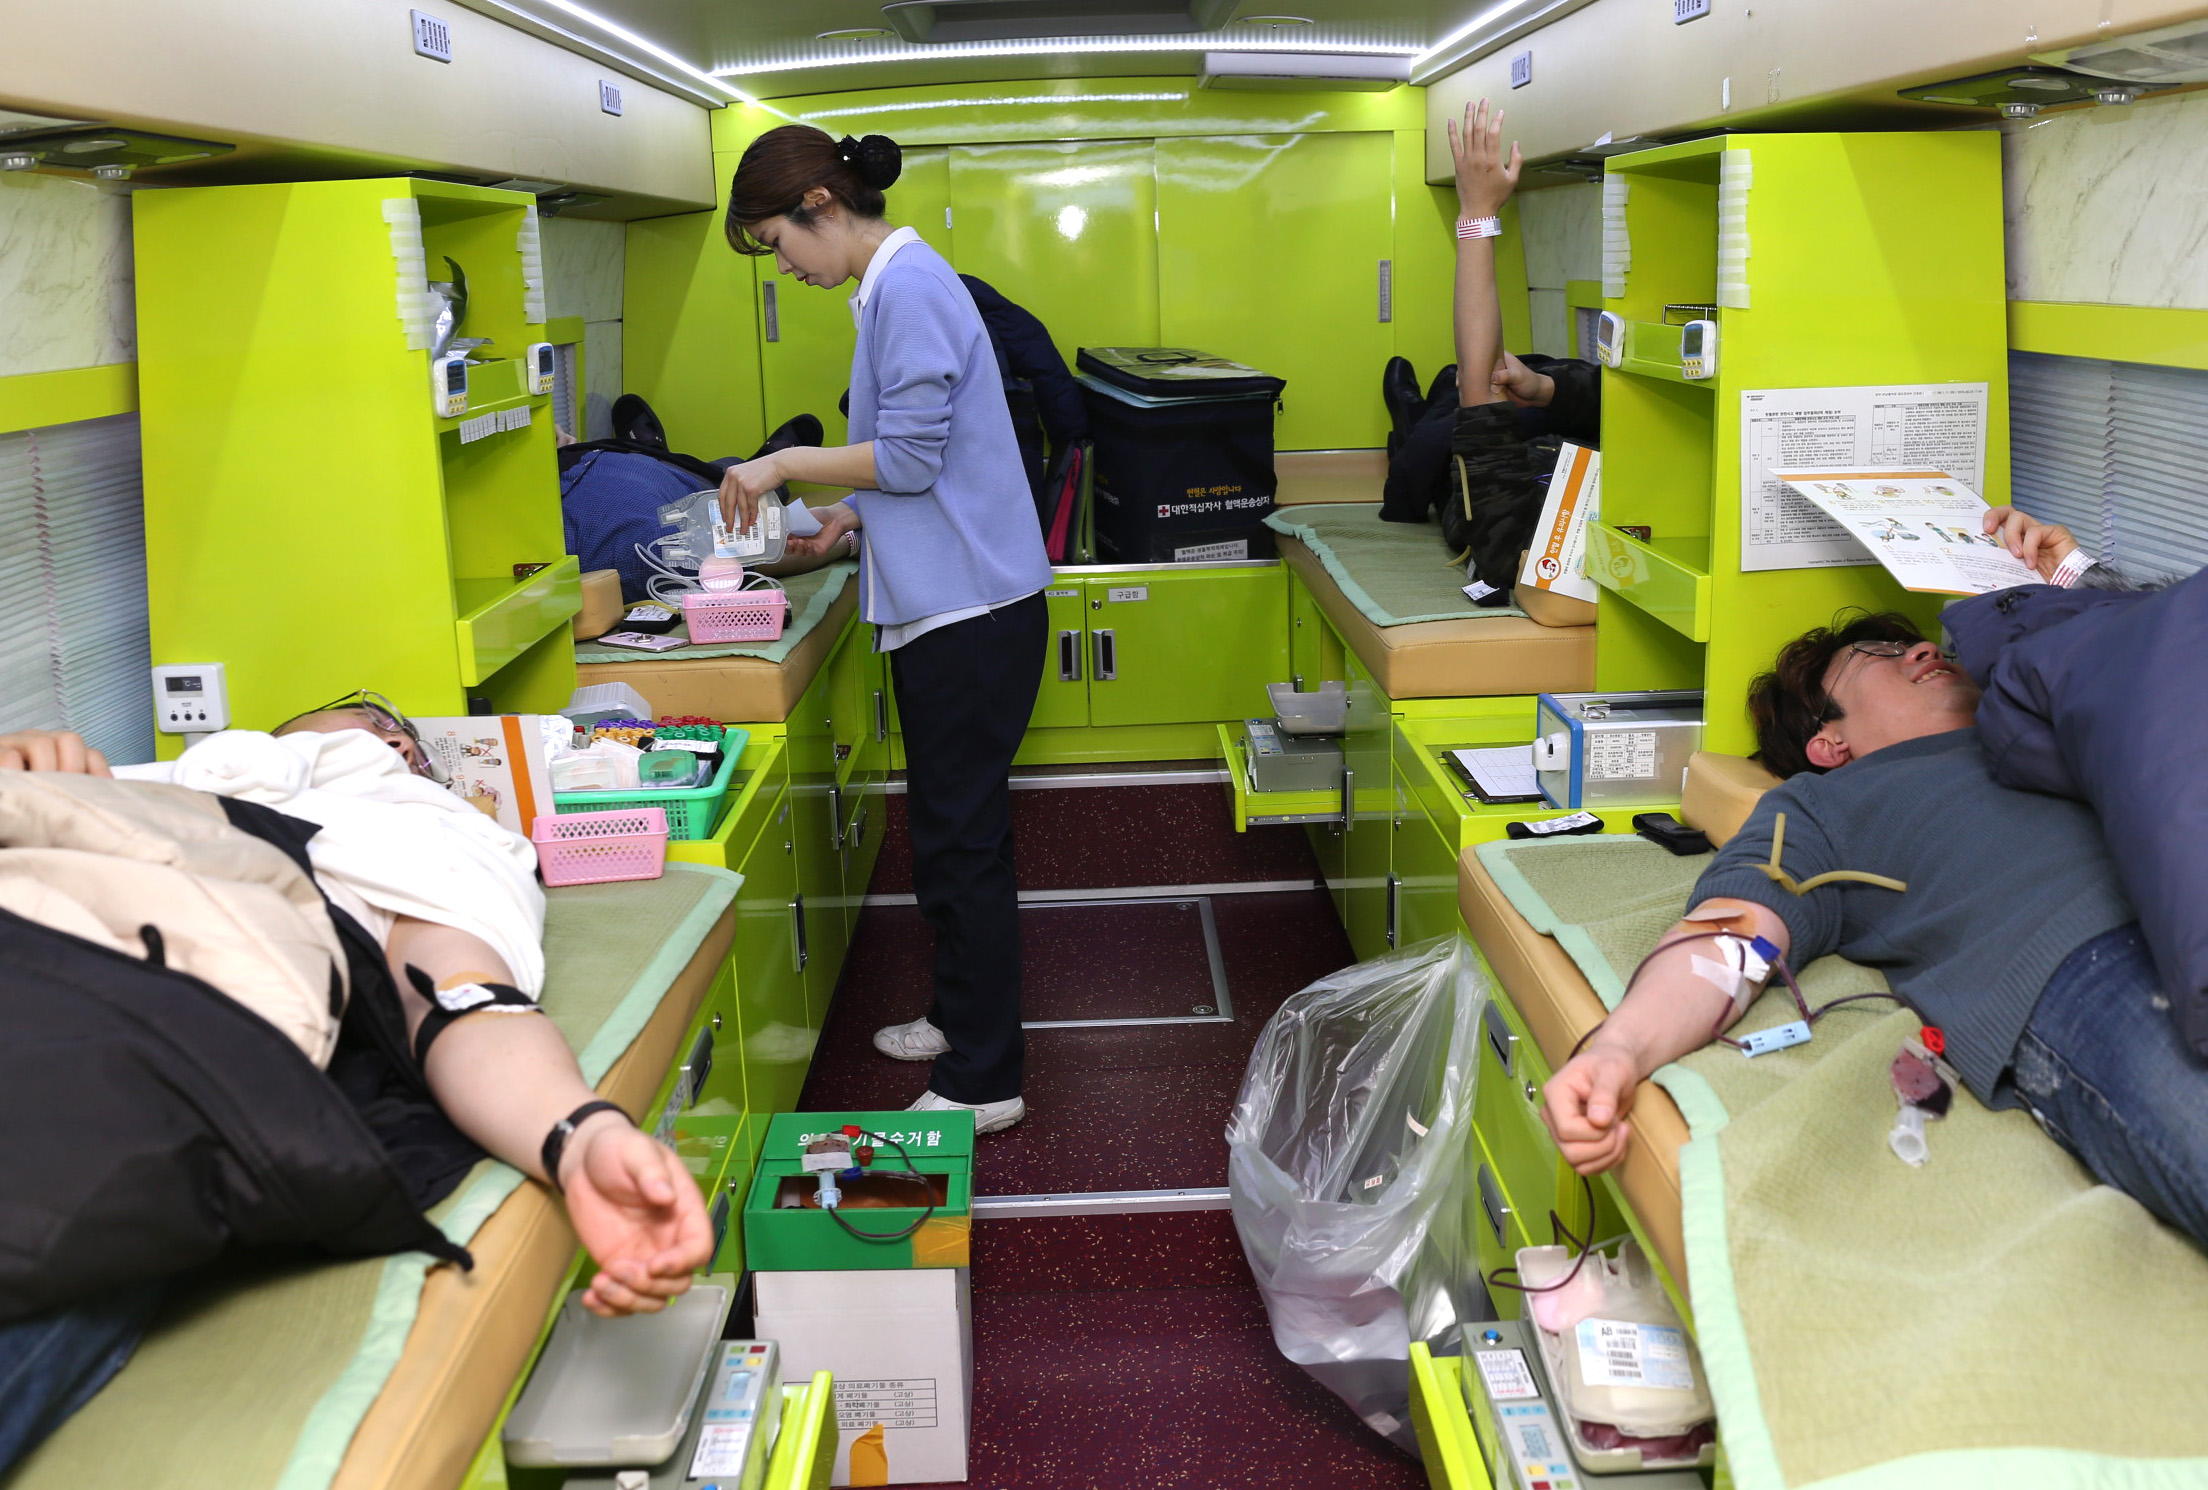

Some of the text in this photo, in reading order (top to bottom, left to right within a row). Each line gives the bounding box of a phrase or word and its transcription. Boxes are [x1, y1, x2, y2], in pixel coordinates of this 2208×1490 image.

[1171, 495, 1270, 515] 대한적십자사 혈액운송상자
[1117, 590, 1139, 600] 구급함
[798, 1130, 941, 1147] 의기물수거함
[848, 1382, 886, 1390] 의료폐기물
[889, 1381, 904, 1389] 종류
